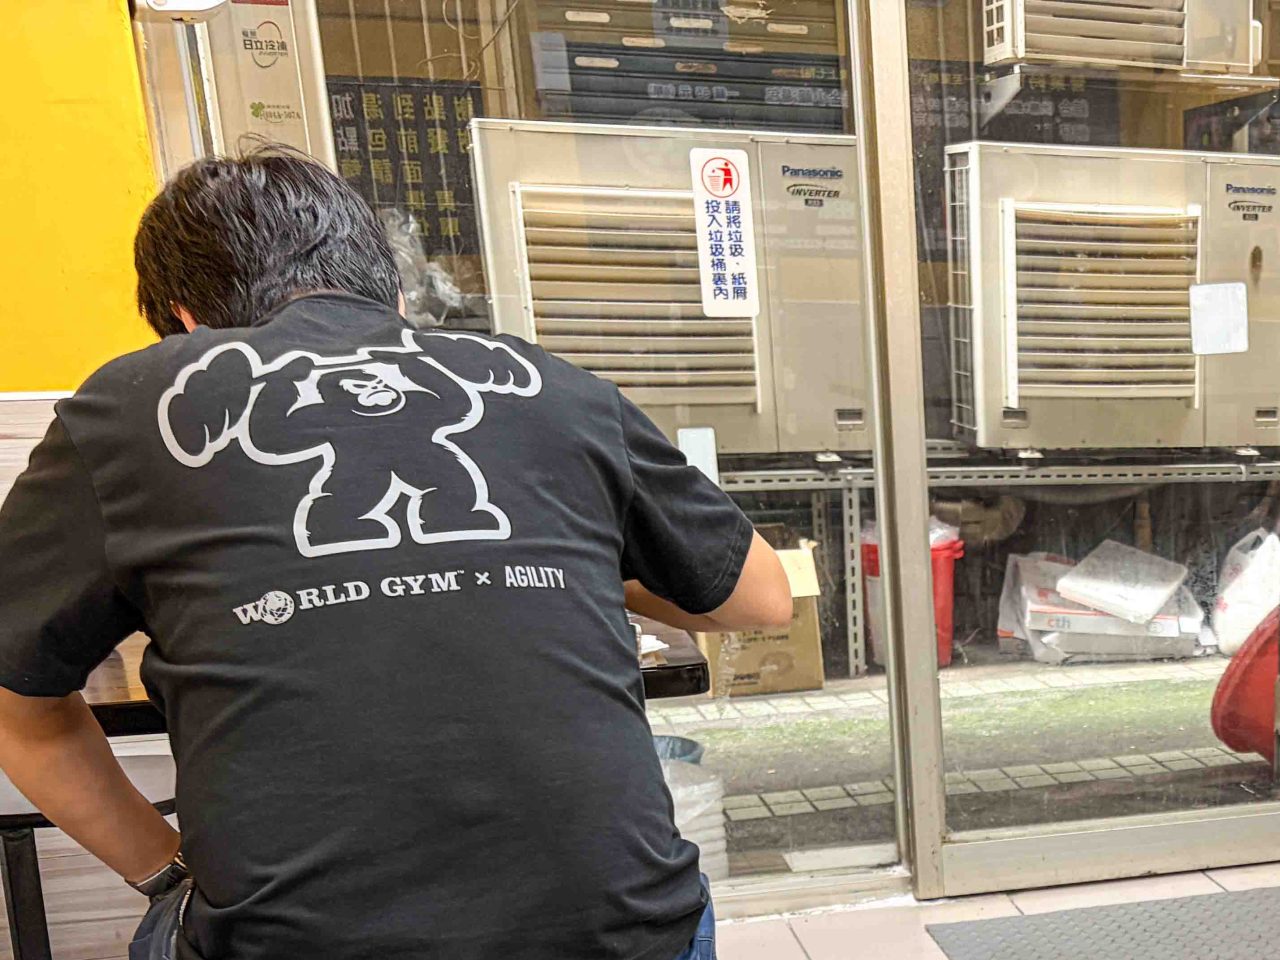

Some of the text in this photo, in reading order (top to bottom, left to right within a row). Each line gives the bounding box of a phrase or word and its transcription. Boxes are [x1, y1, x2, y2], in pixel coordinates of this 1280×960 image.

[781, 165, 843, 178] Panasonic
[791, 188, 841, 198] INVERTER
[1226, 183, 1276, 195] Panasonic
[504, 565, 566, 589] AGILITY
